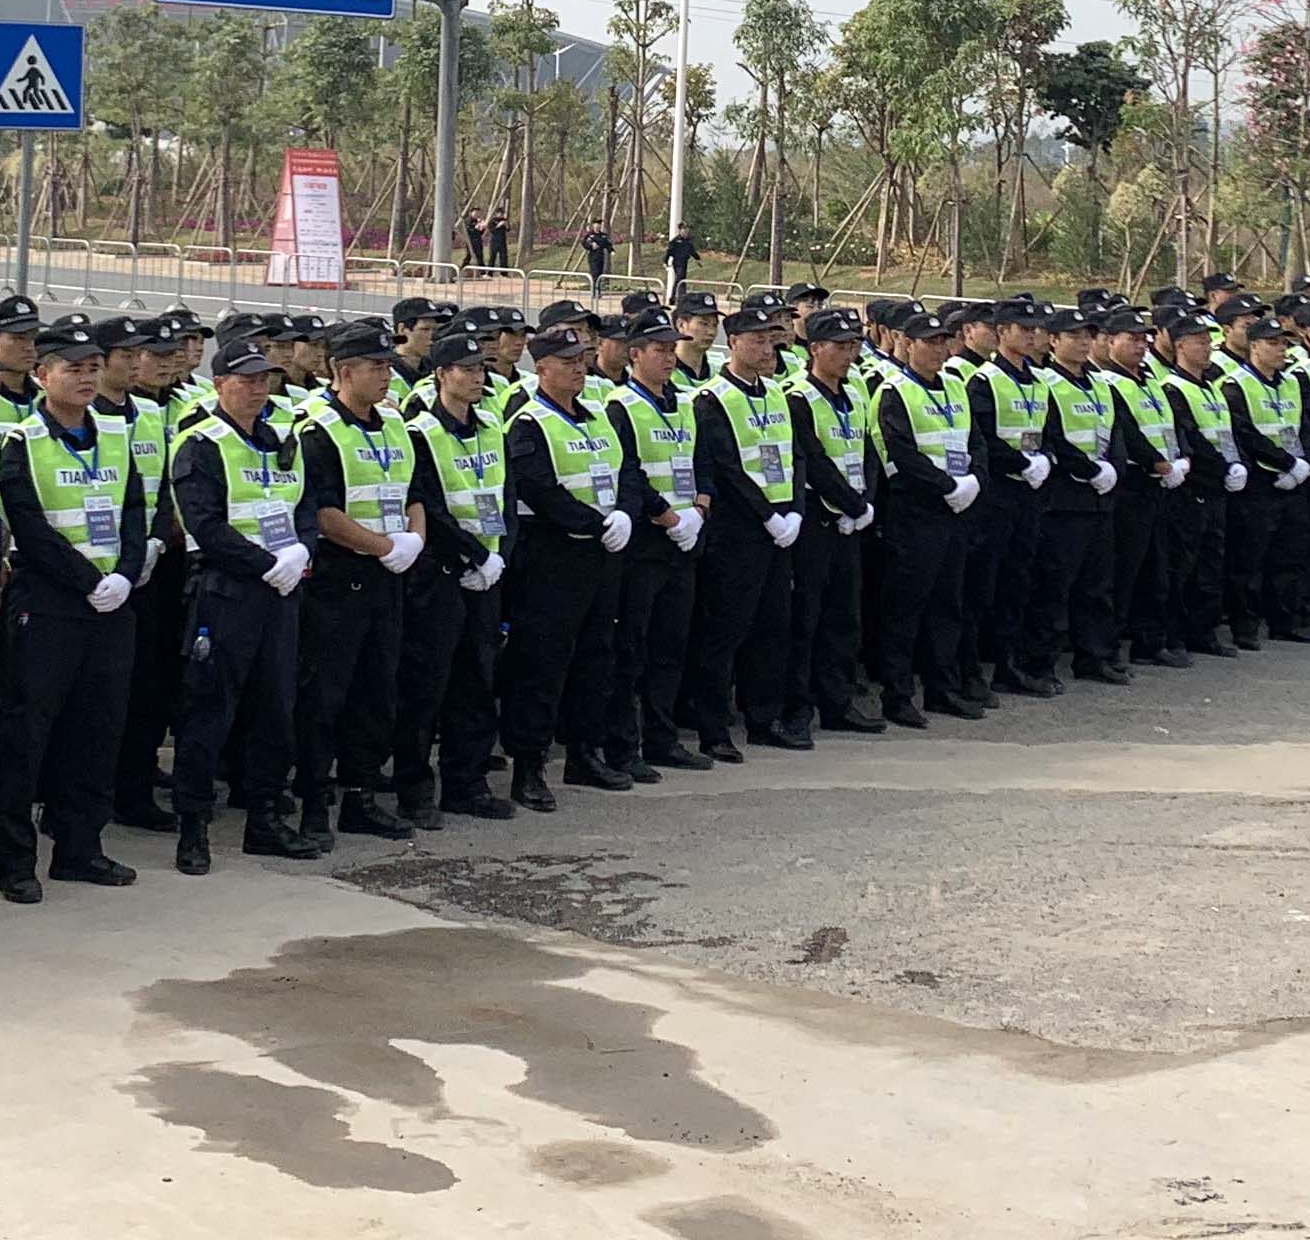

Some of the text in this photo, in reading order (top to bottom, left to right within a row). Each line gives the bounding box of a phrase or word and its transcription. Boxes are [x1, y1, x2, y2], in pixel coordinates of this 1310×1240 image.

[568, 438, 610, 452] TIANUN
[357, 448, 404, 461] TIAUN
[454, 452, 499, 470] TIANUN
[60, 469, 118, 484] TIAUN
[243, 470, 298, 484] TIADUN
